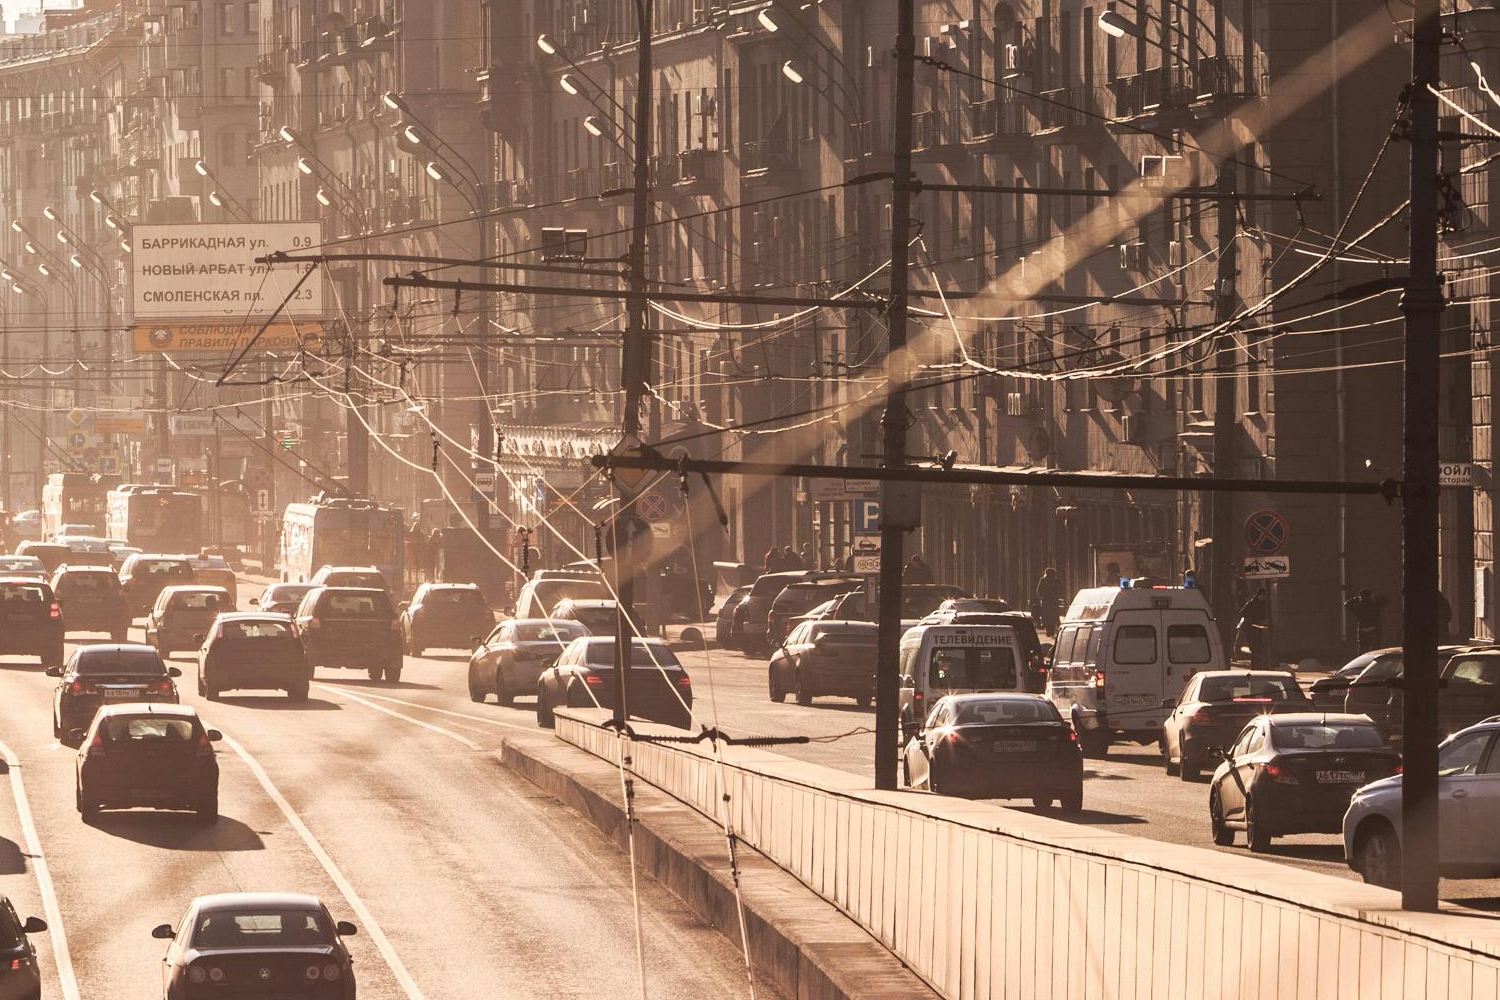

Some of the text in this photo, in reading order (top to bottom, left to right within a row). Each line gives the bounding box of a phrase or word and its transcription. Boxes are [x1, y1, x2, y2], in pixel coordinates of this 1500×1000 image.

[142, 236, 312, 251] БАРРИКАДНАЯ ул. 0.9
[142, 262, 313, 277] НОВЫЙ АРБАТ ул 1.6
[143, 289, 313, 302] СМОЛЕНСКАЯ пл. 2.3
[180, 338, 237, 348] ПРАВИЛА
[863, 501, 880, 529] P
[933, 634, 1013, 646] ТЕЛЕВИДЕНИЕ
